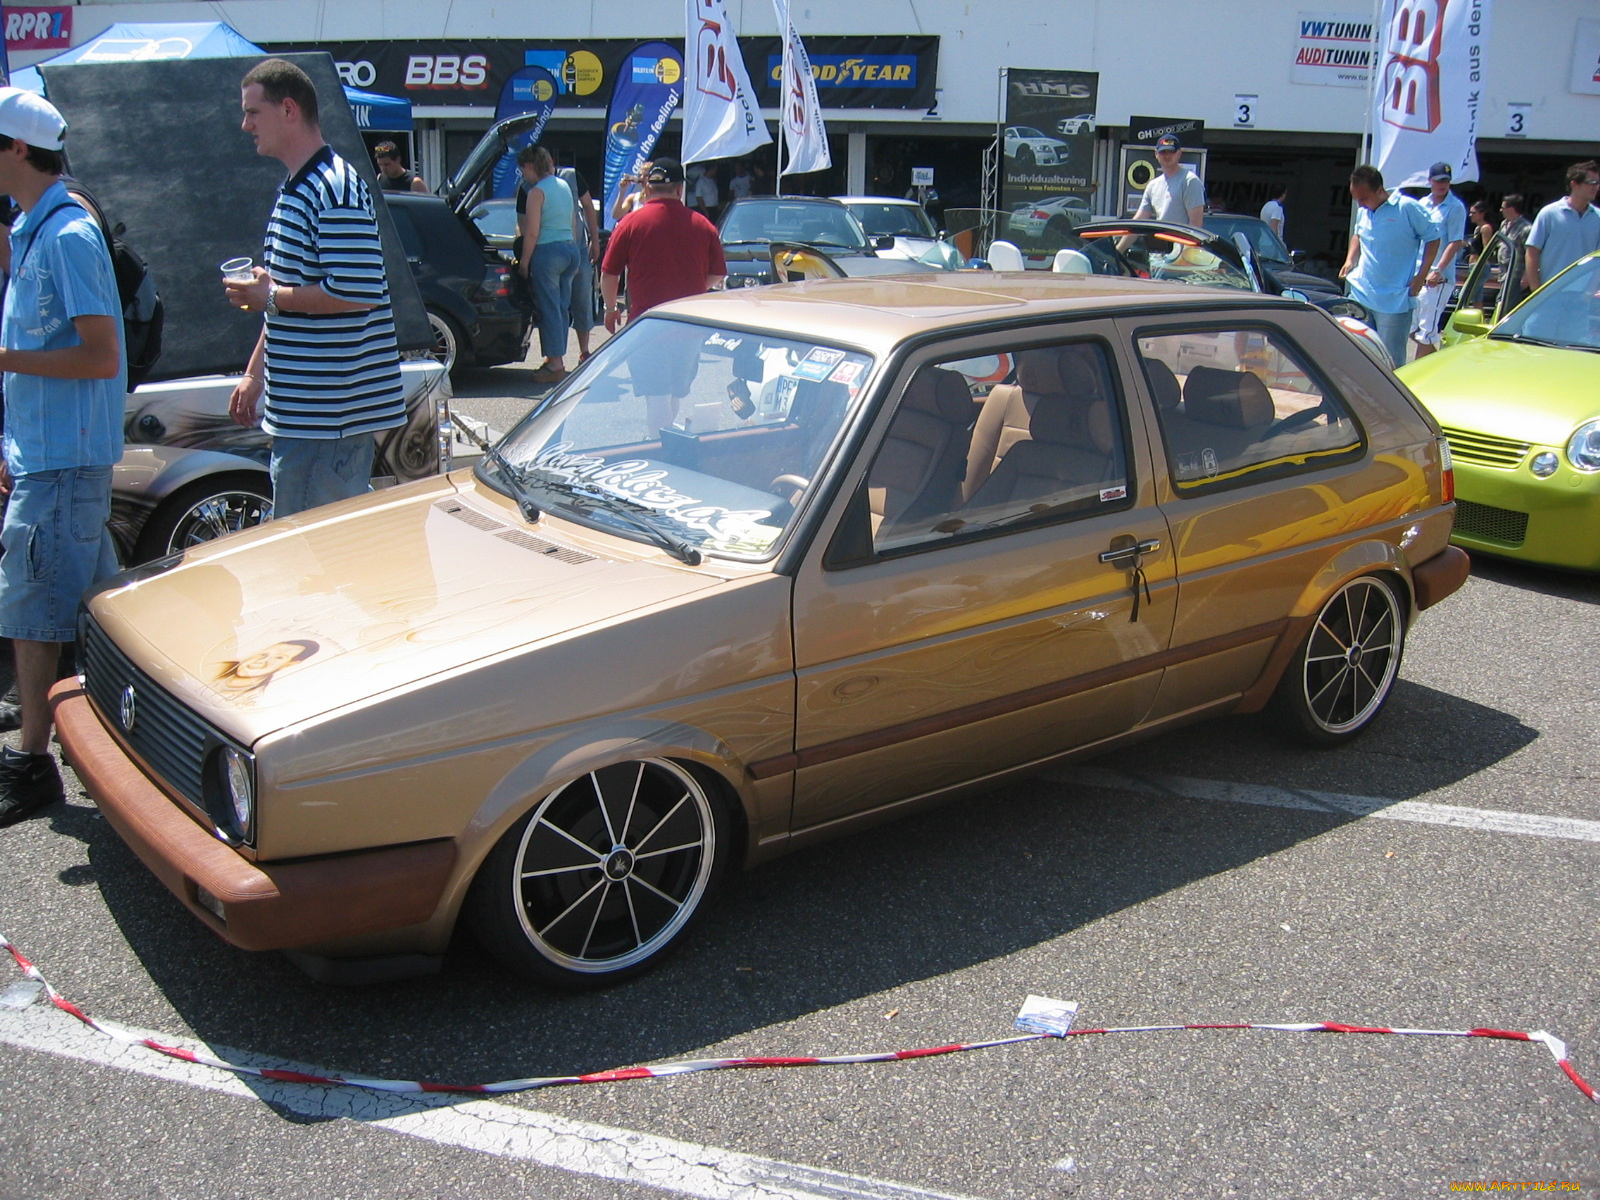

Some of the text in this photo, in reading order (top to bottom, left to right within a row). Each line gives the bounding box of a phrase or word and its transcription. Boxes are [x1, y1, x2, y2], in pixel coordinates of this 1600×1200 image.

[5, 12, 68, 41] RPR1.
[1300, 21, 1379, 40] VWTUNIN
[404, 55, 489, 89] BBS
[771, 64, 911, 81] GODYEAR
[1469, 46, 1480, 82] aus
[1011, 82, 1091, 99] HMS
[640, 134, 655, 155] the
[651, 88, 681, 134] feeling!
[1238, 104, 1250, 123] 3
[1511, 113, 1524, 132] 3
[1138, 130, 1152, 140] GH
[1007, 173, 1086, 187] Individualtuning
[44, 317, 62, 334] CLUB
